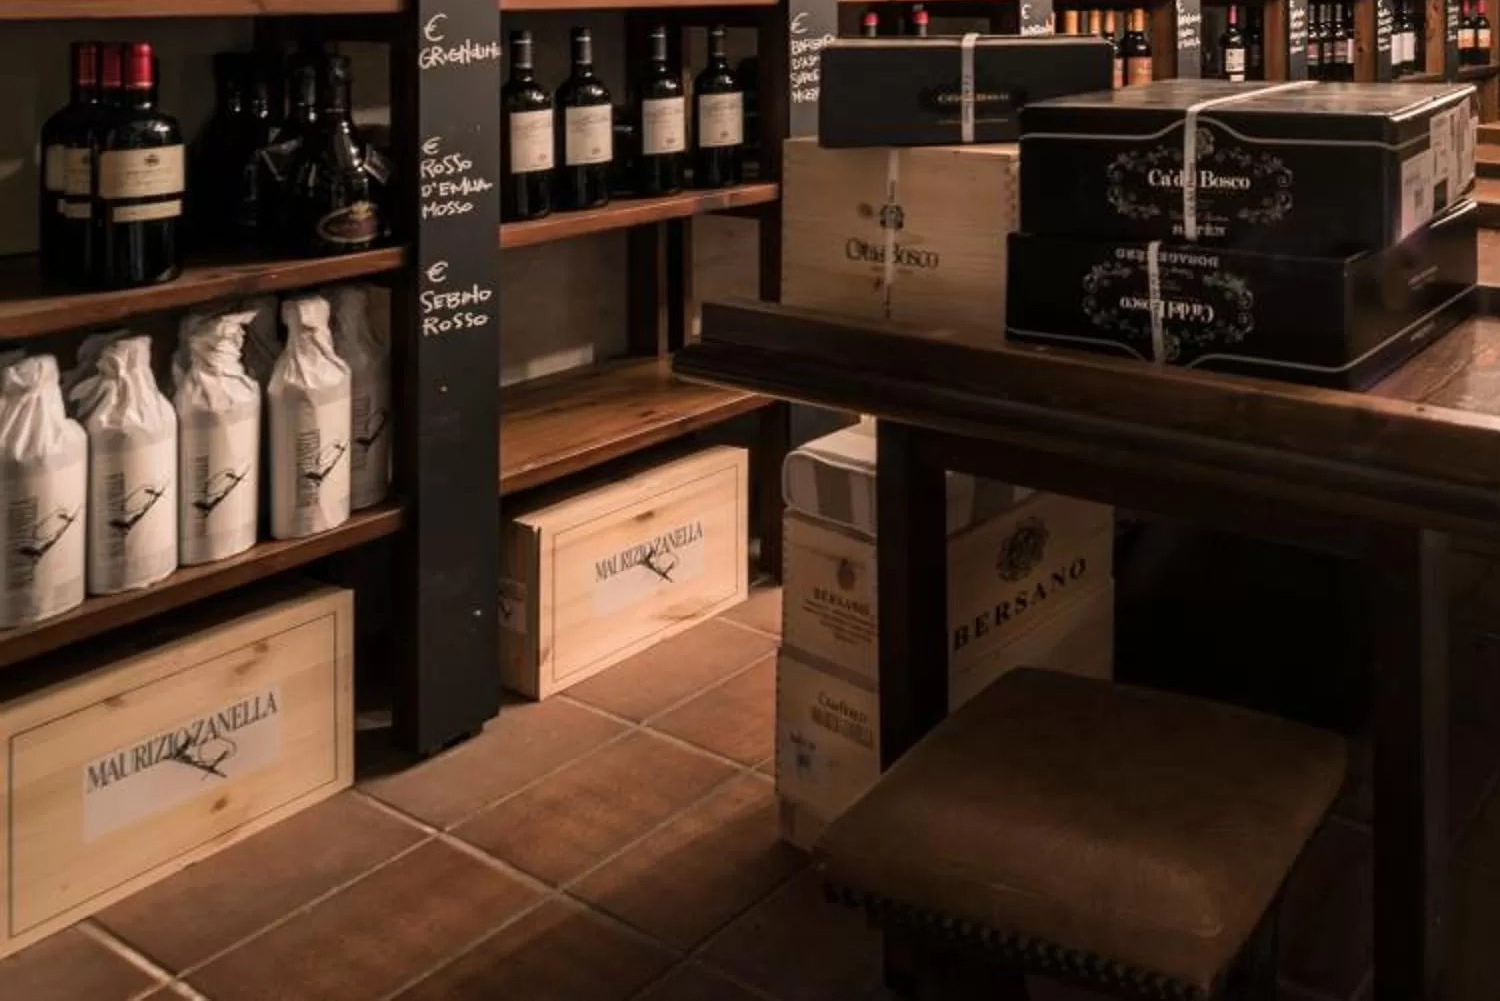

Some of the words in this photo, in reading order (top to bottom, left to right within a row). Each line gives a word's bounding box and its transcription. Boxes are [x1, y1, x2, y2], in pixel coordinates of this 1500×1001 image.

[1200, 170, 1251, 190] Bosco
[422, 312, 489, 337] ROSSO
[953, 557, 1089, 652] BERSANO
[87, 726, 191, 794] MAURIZIO
[189, 691, 279, 746] ZANELLA
